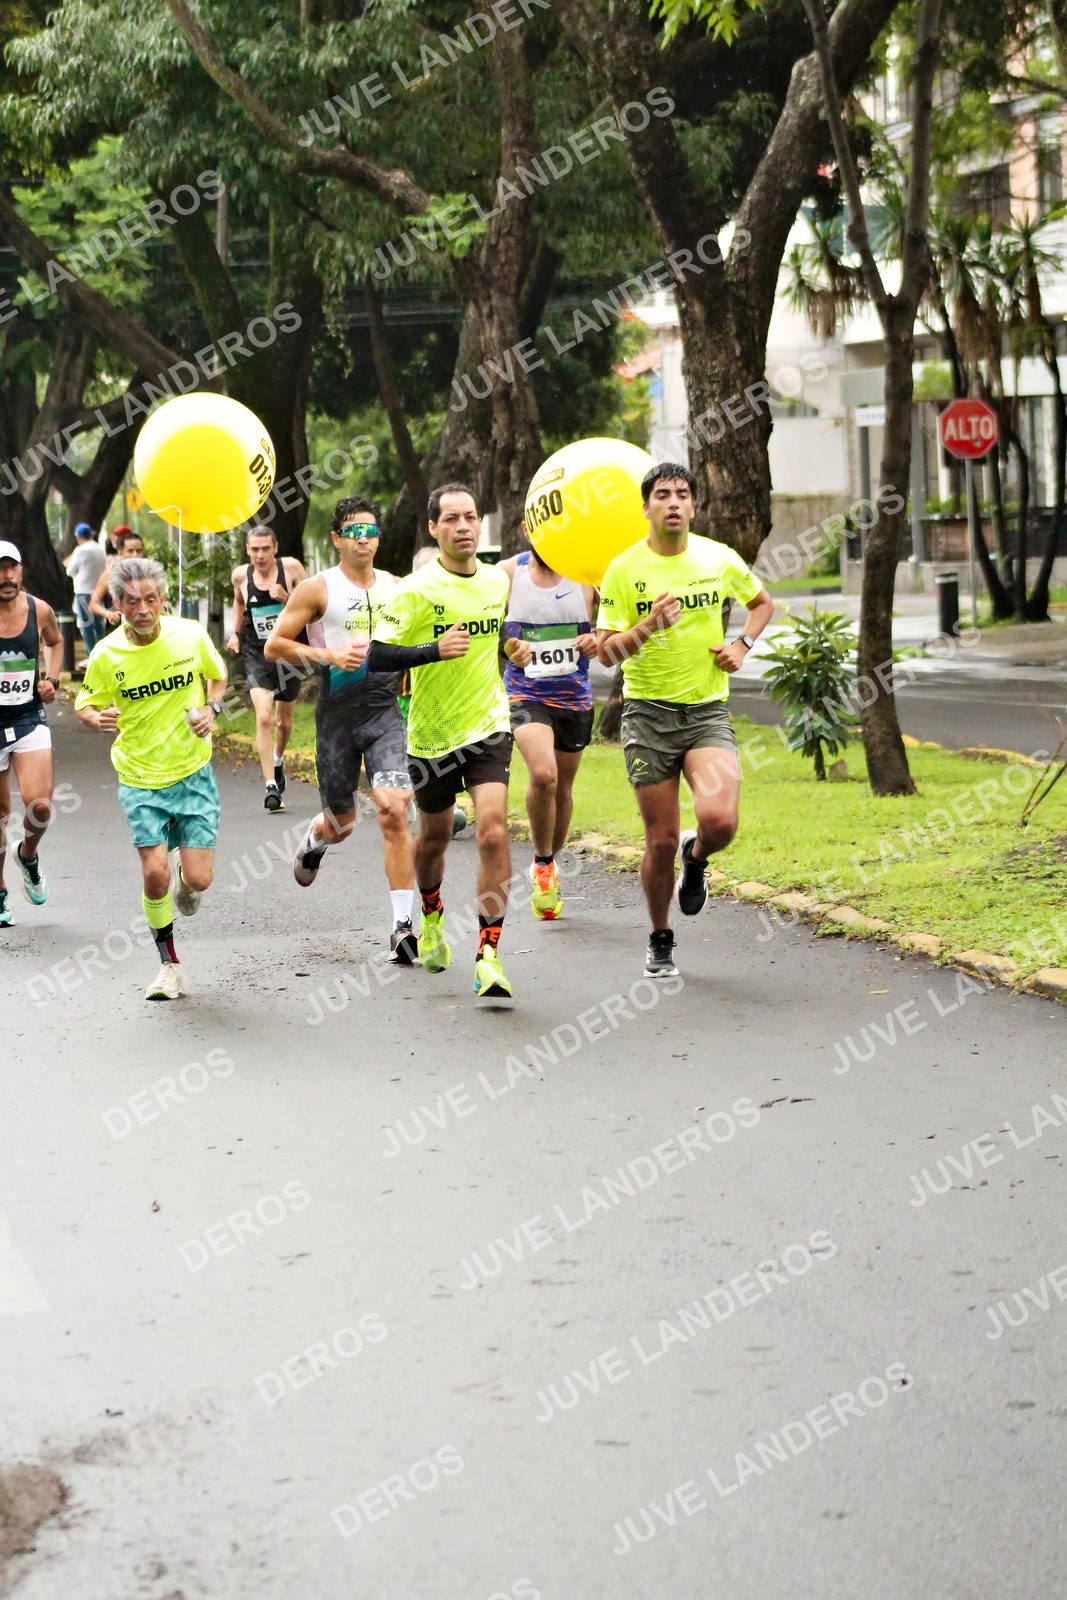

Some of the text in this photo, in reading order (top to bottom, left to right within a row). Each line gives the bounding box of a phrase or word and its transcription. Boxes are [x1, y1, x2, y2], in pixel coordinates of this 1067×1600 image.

[944, 415, 993, 441] ALTO
[525, 489, 564, 534] 01:30
[635, 591, 720, 617] PDURA
[257, 620, 276, 633] 56
[531, 647, 574, 666] 1601
[120, 671, 194, 701] PERDURA
